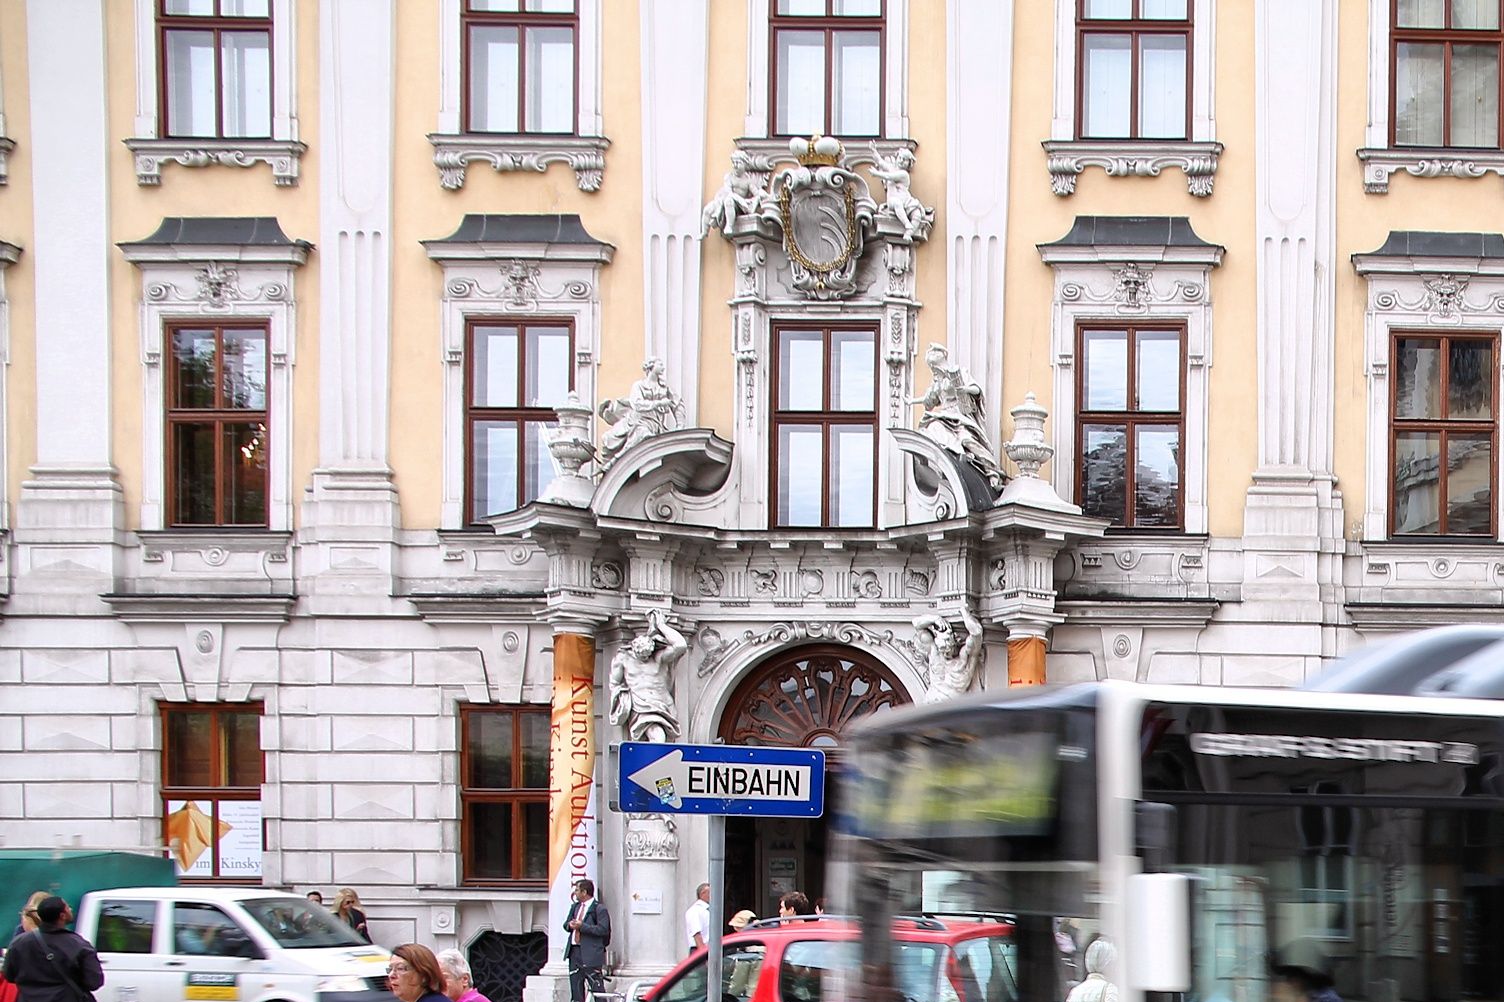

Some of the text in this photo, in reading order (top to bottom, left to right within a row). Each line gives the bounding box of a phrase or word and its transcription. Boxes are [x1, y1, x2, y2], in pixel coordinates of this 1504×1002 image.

[570, 674, 594, 760] Kunst
[688, 766, 800, 796] EINBAHN
[196, 857, 261, 872] im Kinsky
